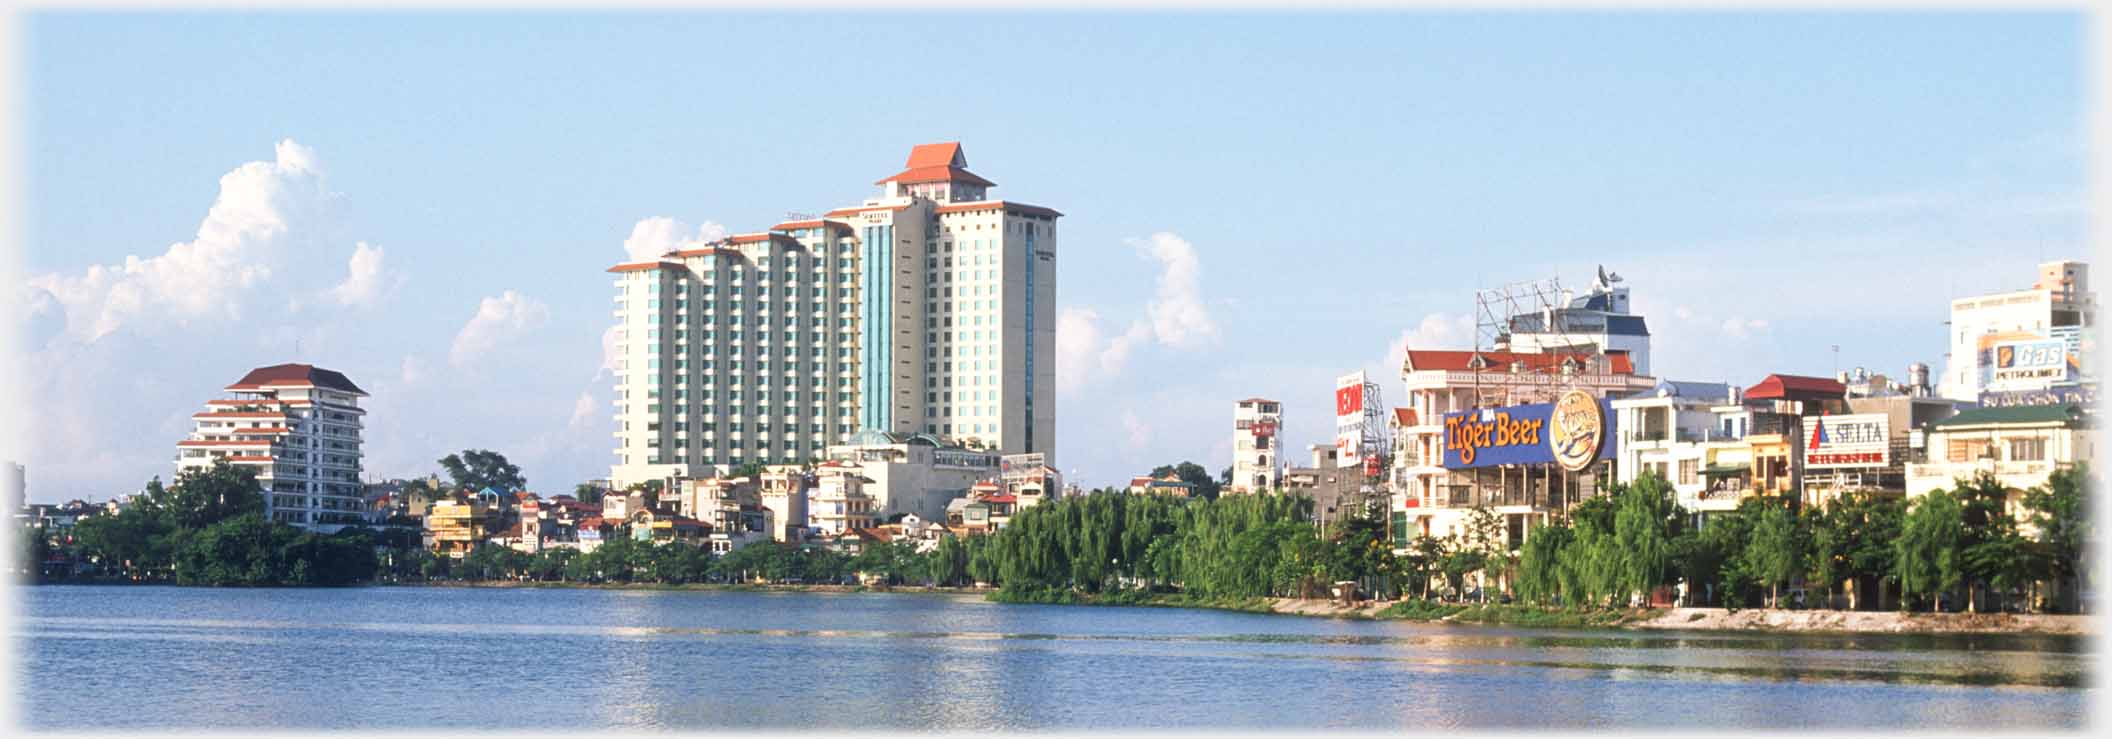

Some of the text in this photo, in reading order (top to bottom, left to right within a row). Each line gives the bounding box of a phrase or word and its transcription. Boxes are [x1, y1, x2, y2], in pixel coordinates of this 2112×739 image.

[1446, 412, 1495, 465] Tiger
[1495, 412, 1543, 447] Beer
[1836, 422, 1883, 443] SELTA
